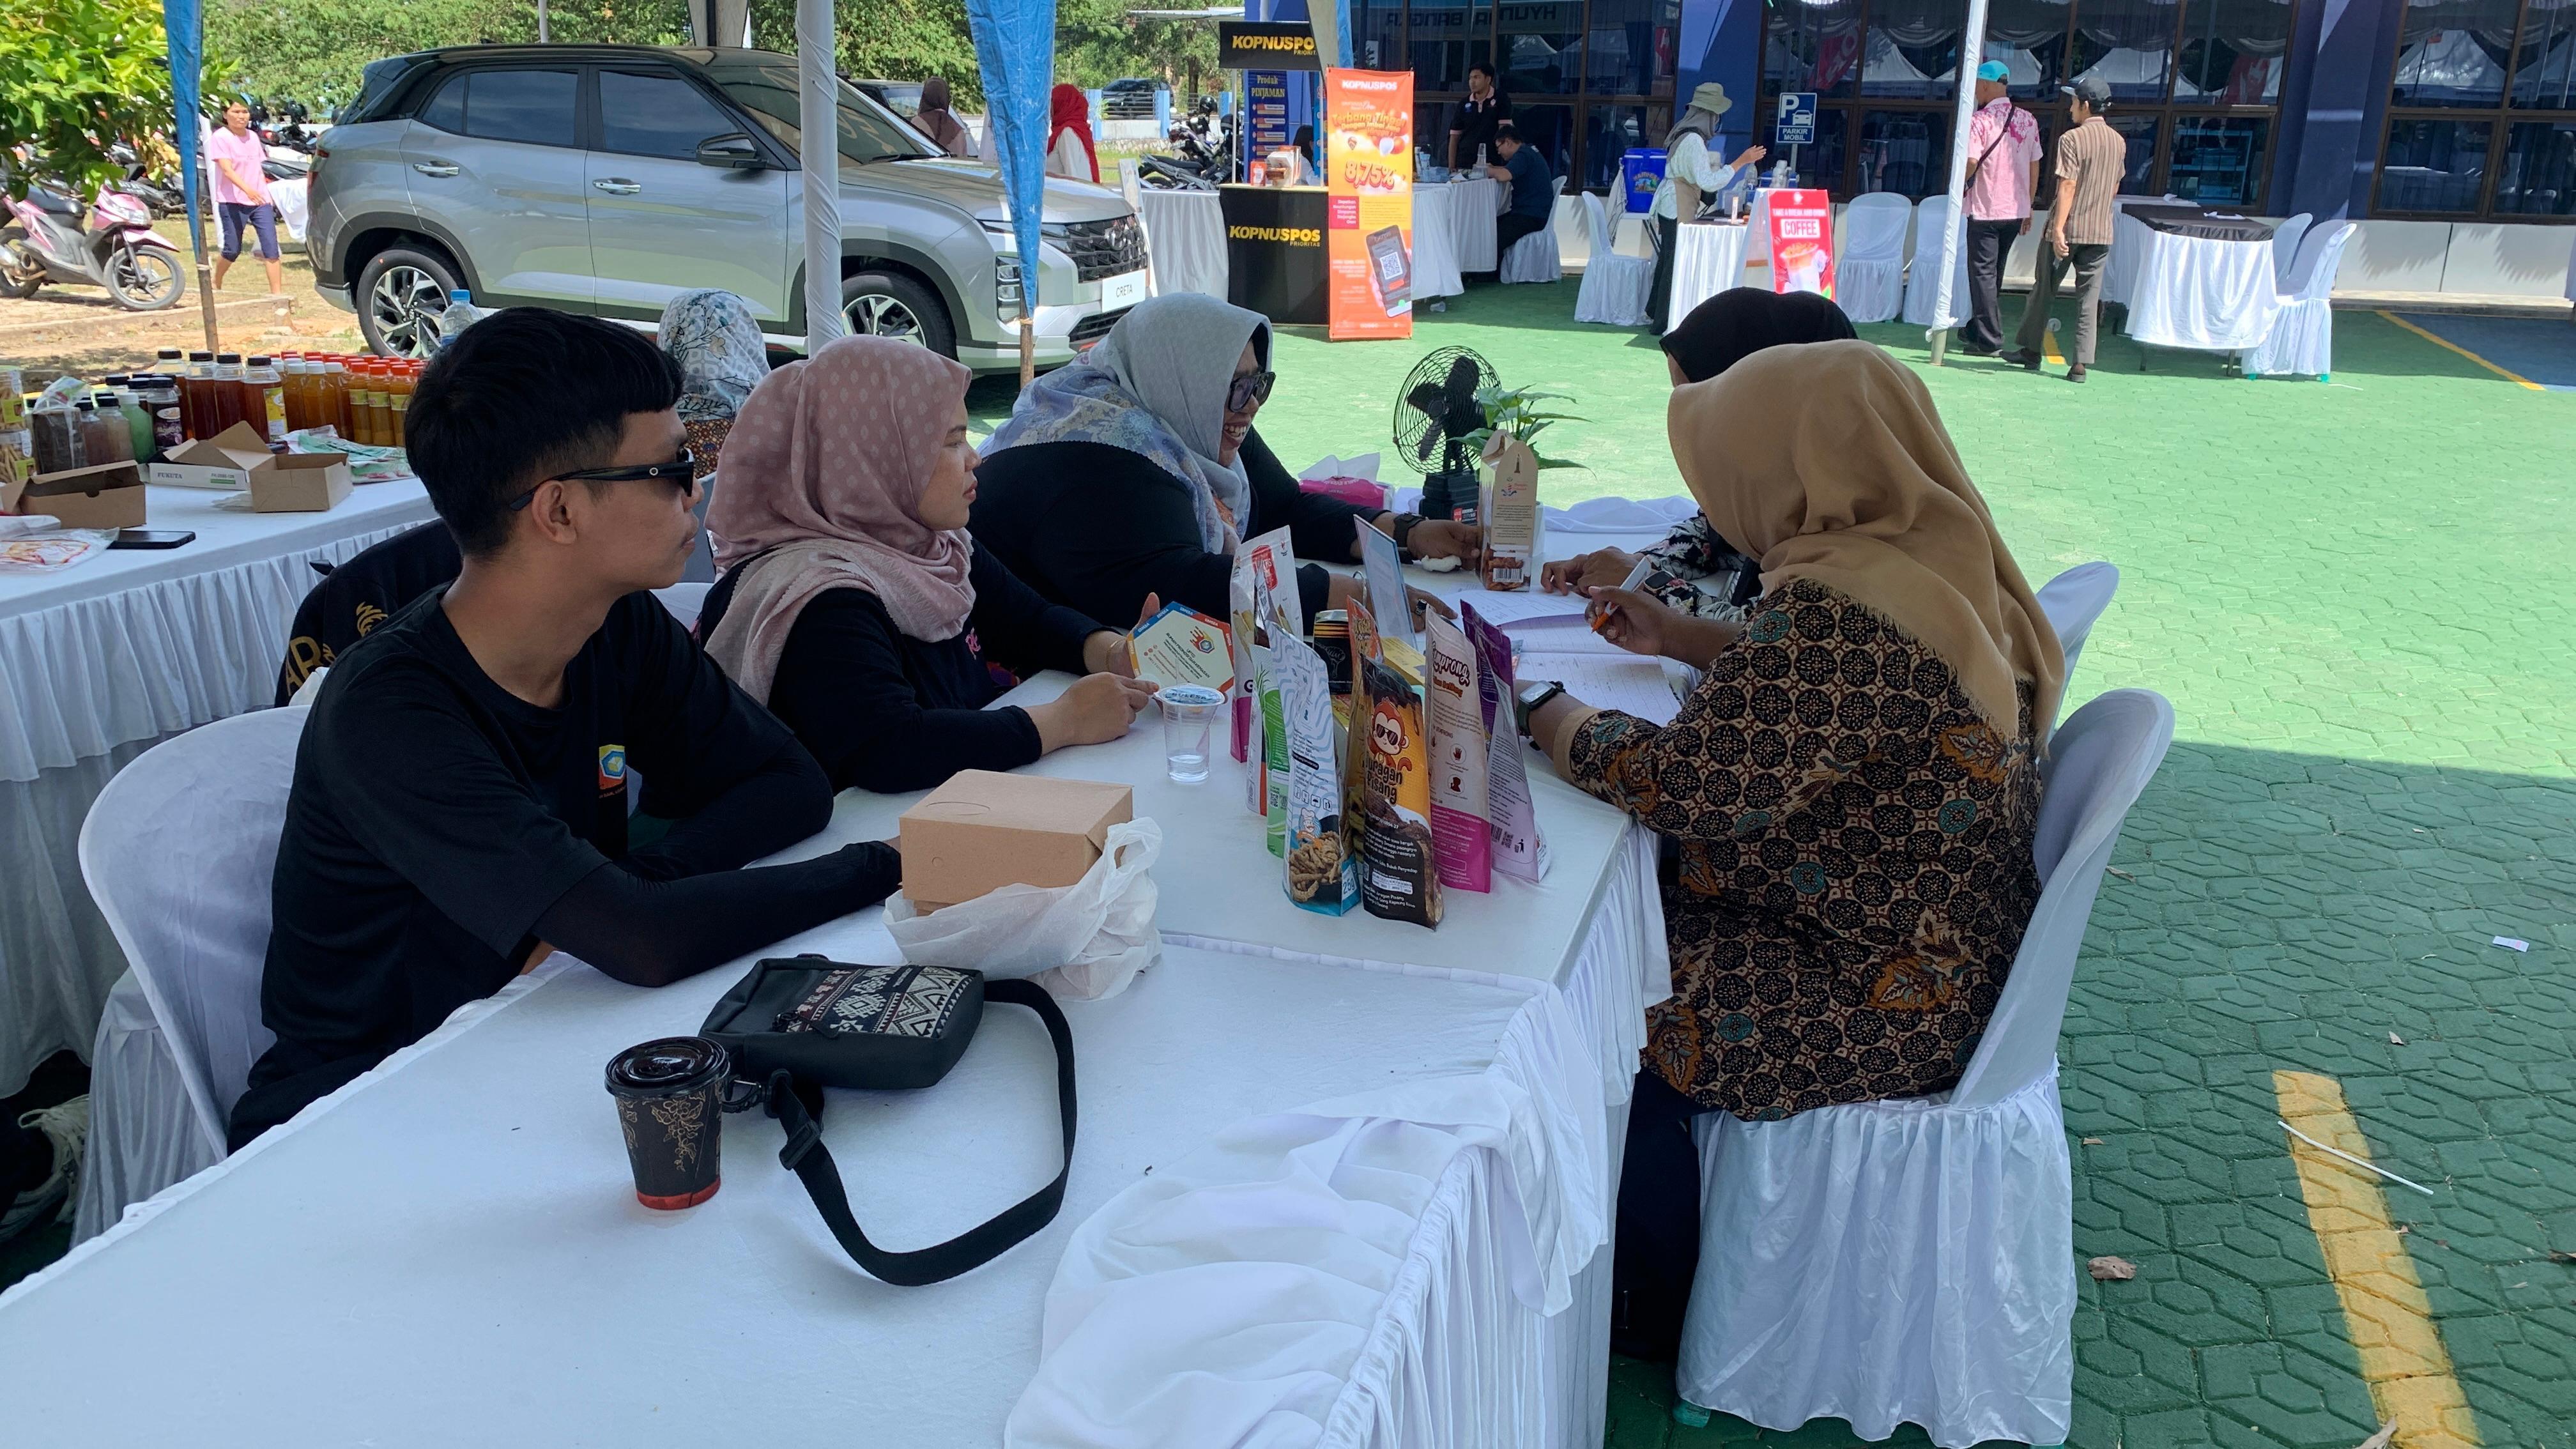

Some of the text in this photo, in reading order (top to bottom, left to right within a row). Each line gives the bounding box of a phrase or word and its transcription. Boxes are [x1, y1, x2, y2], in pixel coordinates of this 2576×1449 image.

[1257, 75, 1278, 84] Produk
[1342, 80, 1397, 90] KOPNUSPOS
[1252, 88, 1285, 99] PINJAMAN
[1780, 95, 1799, 118] P
[1345, 160, 1395, 190] 8,75%
[1229, 226, 1321, 242] KOPNUSPOS
[1784, 220, 1817, 236] COFFEE
[1116, 284, 1133, 298] CRETA
[1367, 771, 1397, 805] Pisang
